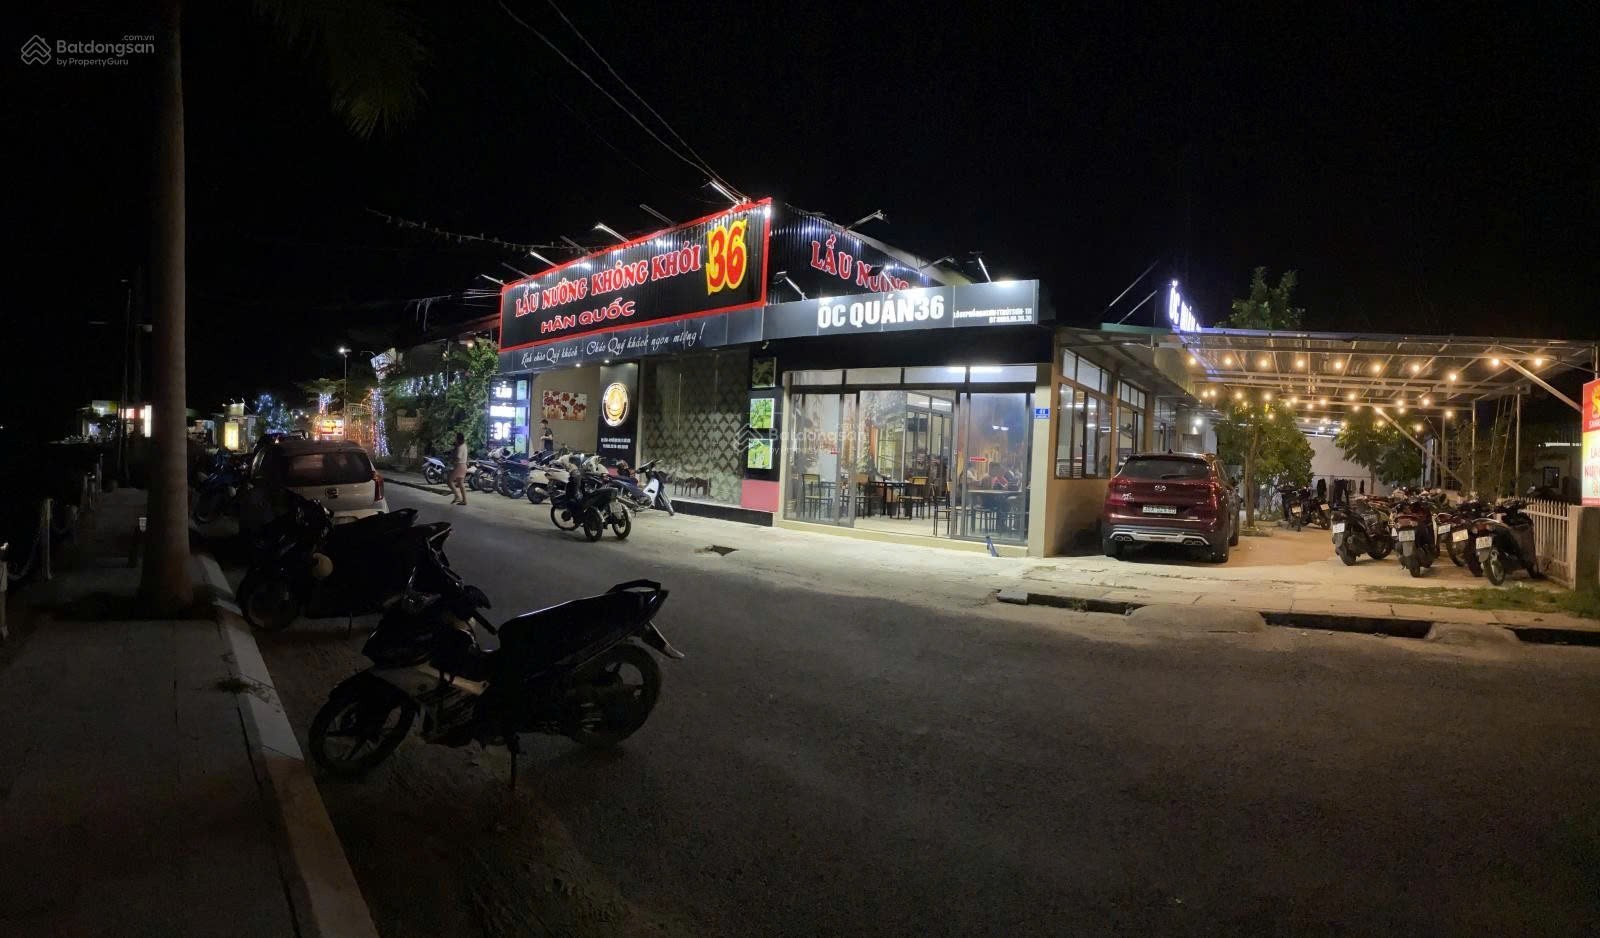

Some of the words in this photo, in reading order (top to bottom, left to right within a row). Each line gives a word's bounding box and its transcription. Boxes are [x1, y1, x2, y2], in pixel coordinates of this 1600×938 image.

[591, 260, 649, 296] KHÔNG
[651, 241, 701, 281] KHÓI
[706, 219, 747, 296] 36
[579, 297, 636, 325] QUỐC
